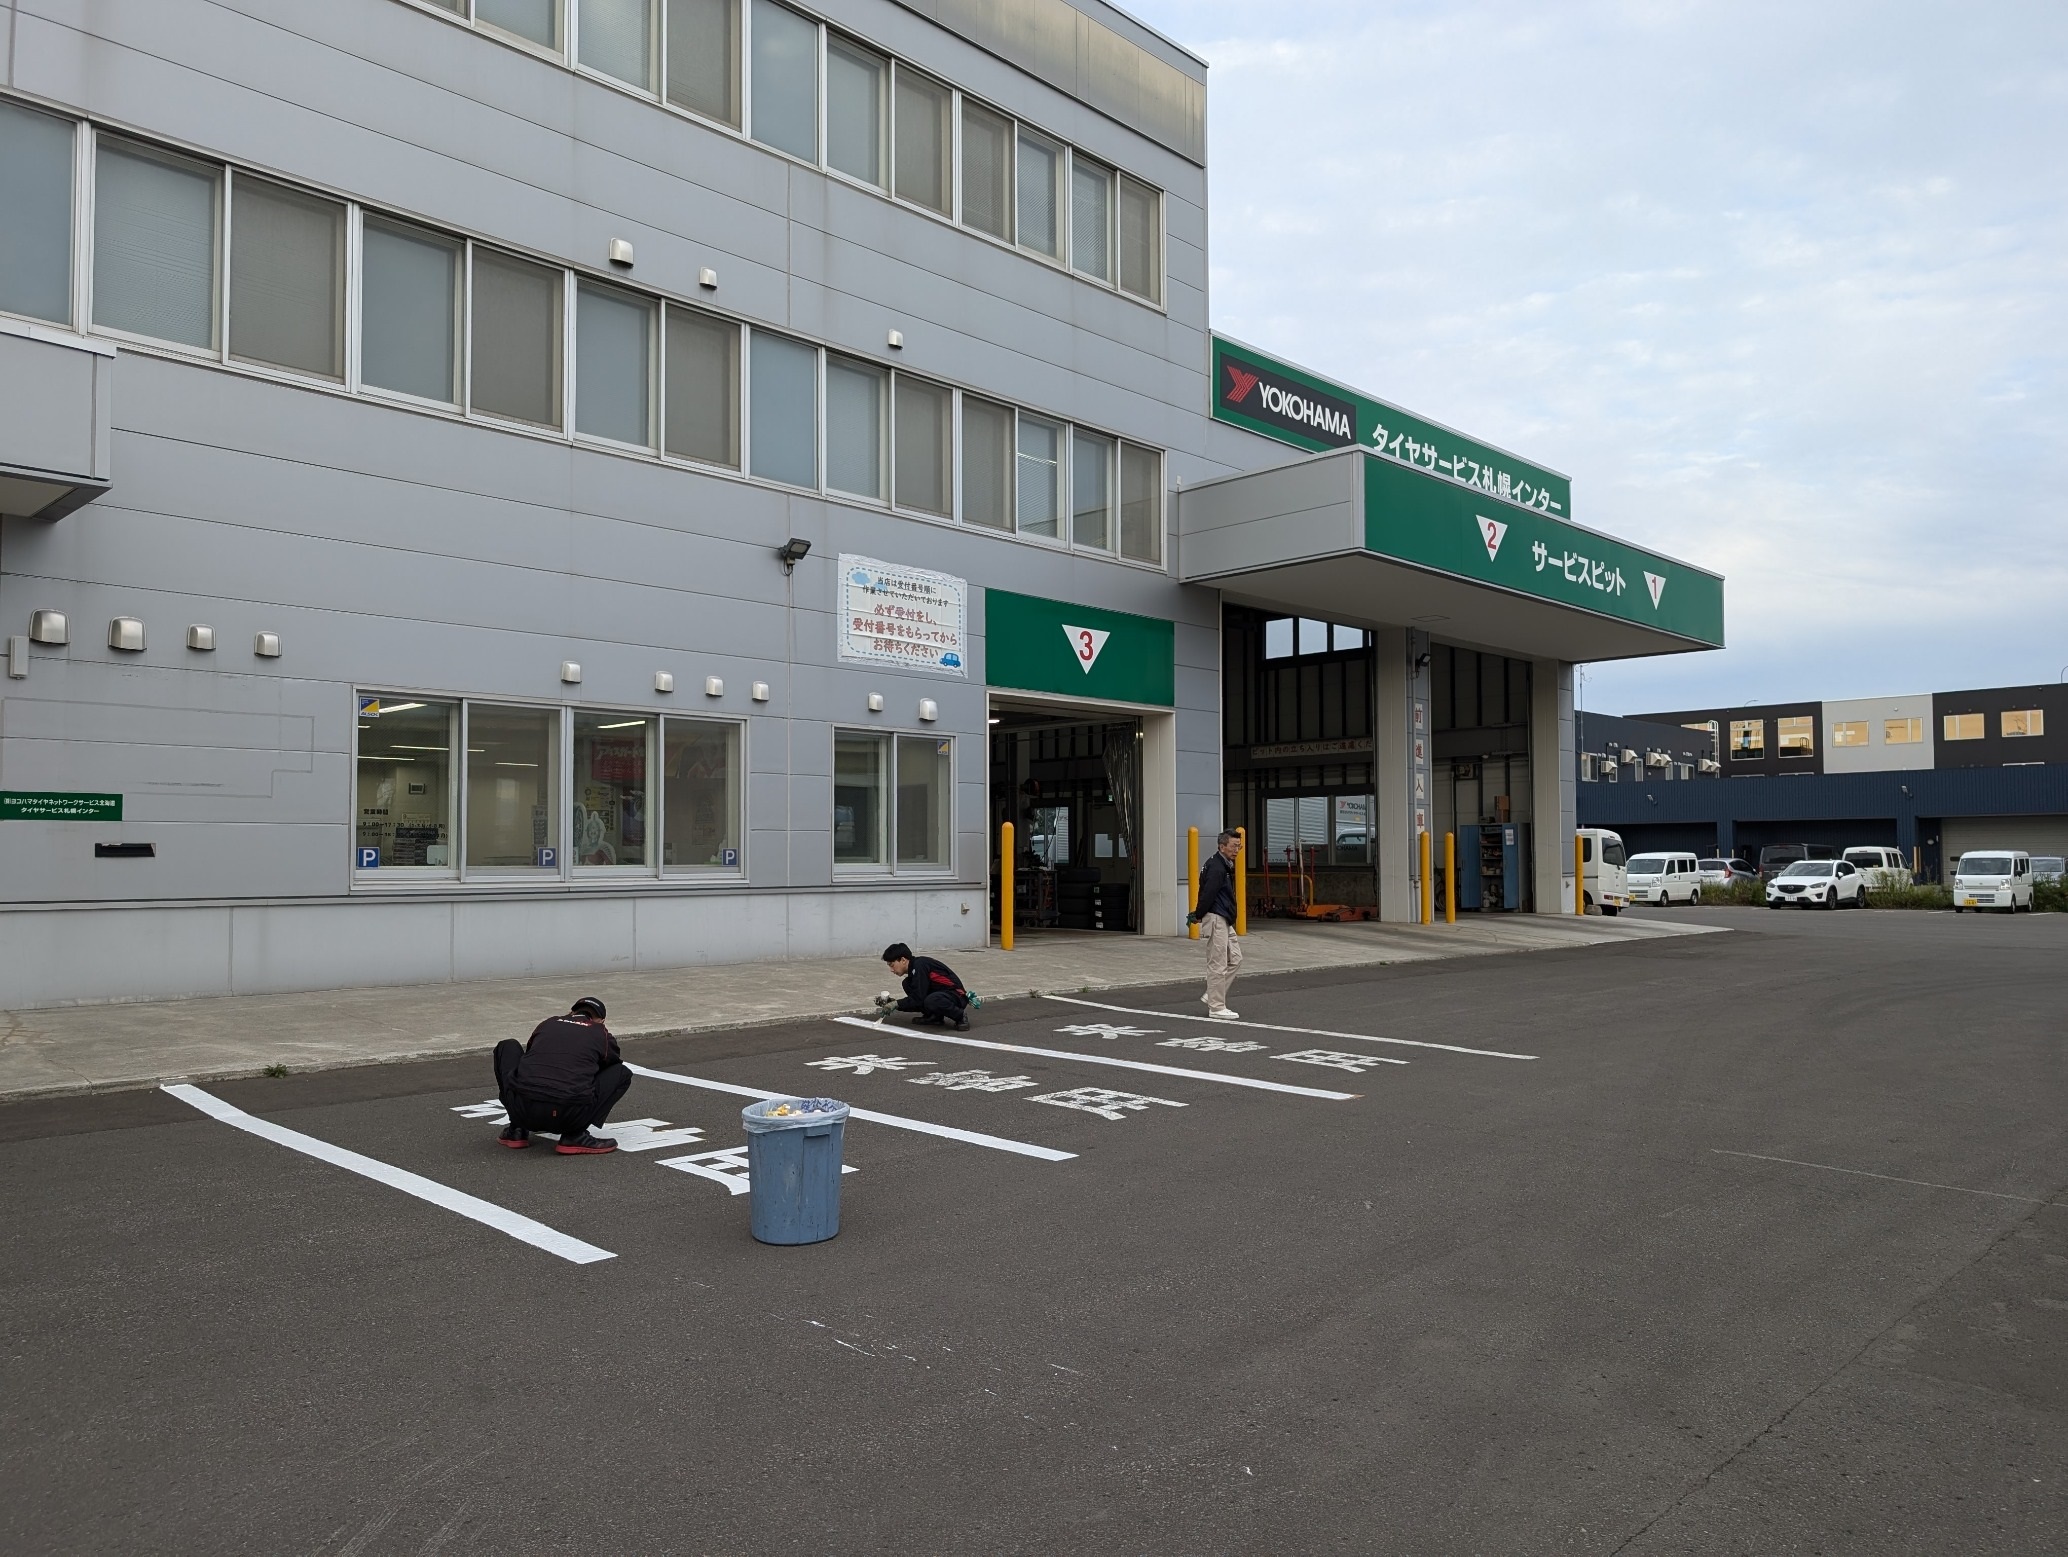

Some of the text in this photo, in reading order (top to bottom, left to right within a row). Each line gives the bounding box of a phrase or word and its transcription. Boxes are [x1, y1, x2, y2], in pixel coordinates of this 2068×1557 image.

[1258, 382, 1352, 440] YOKOHAMA
[1372, 423, 1562, 512] タイヤサービス札幌インター
[1487, 522, 1658, 600] 2 サービスピット 1
[852, 617, 958, 646] 受付番号をもらってから
[1079, 630, 1094, 661] 3
[873, 638, 939, 658] お待ちください
[363, 849, 376, 867] P
[542, 849, 554, 866] P
[725, 850, 735, 865] P
